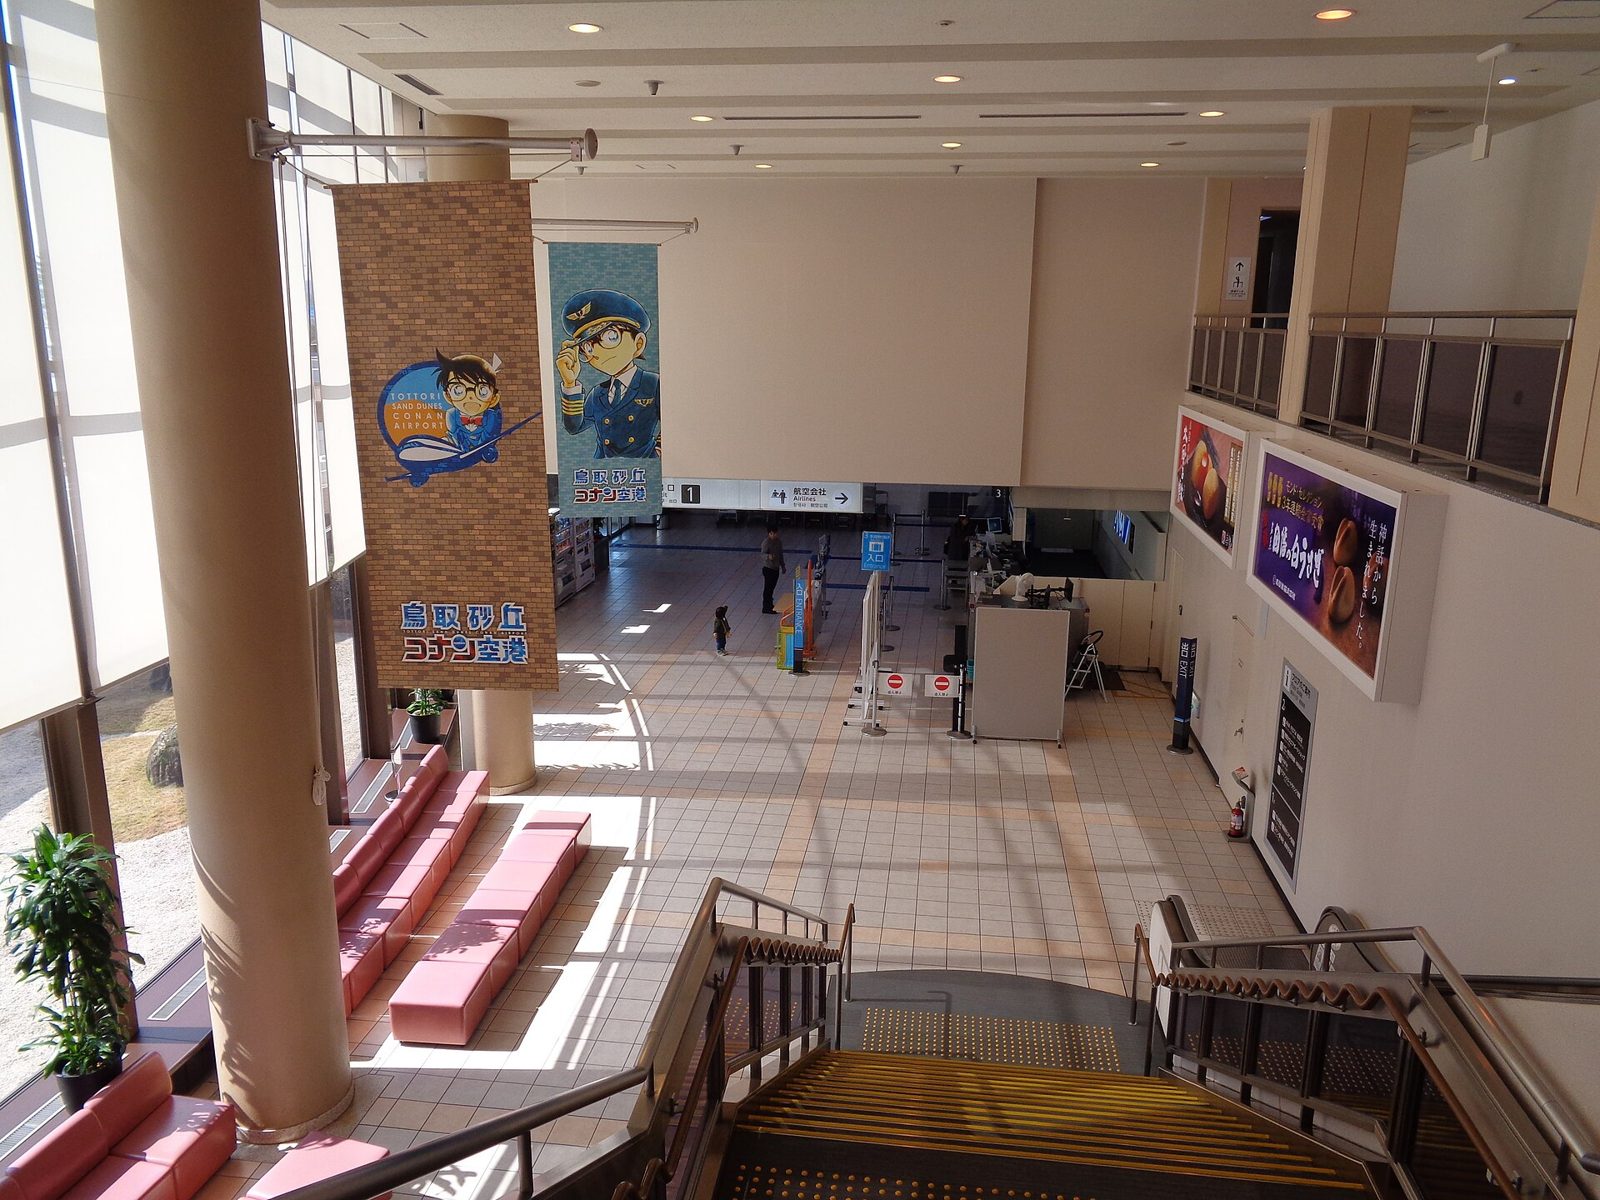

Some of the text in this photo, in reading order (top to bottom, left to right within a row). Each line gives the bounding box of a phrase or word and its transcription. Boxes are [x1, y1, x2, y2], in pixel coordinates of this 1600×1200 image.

[390, 392, 441, 401] TOTTORI
[391, 402, 443, 410] SAND DUNES
[392, 412, 444, 420] CONAN
[393, 421, 444, 430] AIRPORT
[572, 467, 646, 486] 鳥取砂丘
[573, 485, 647, 504] コナン空港
[687, 487, 693, 502] 1
[793, 487, 827, 496] 航空会社
[866, 553, 884, 563] 入口
[1370, 522, 1388, 605] 神話から
[796, 583, 803, 596] 入口
[1355, 519, 1378, 649] 生まれました。
[400, 600, 527, 631] 鳥取砂丘
[401, 634, 529, 665] コナン空港
[1181, 642, 1189, 658] 出口
[1179, 660, 1188, 679] EXIT
